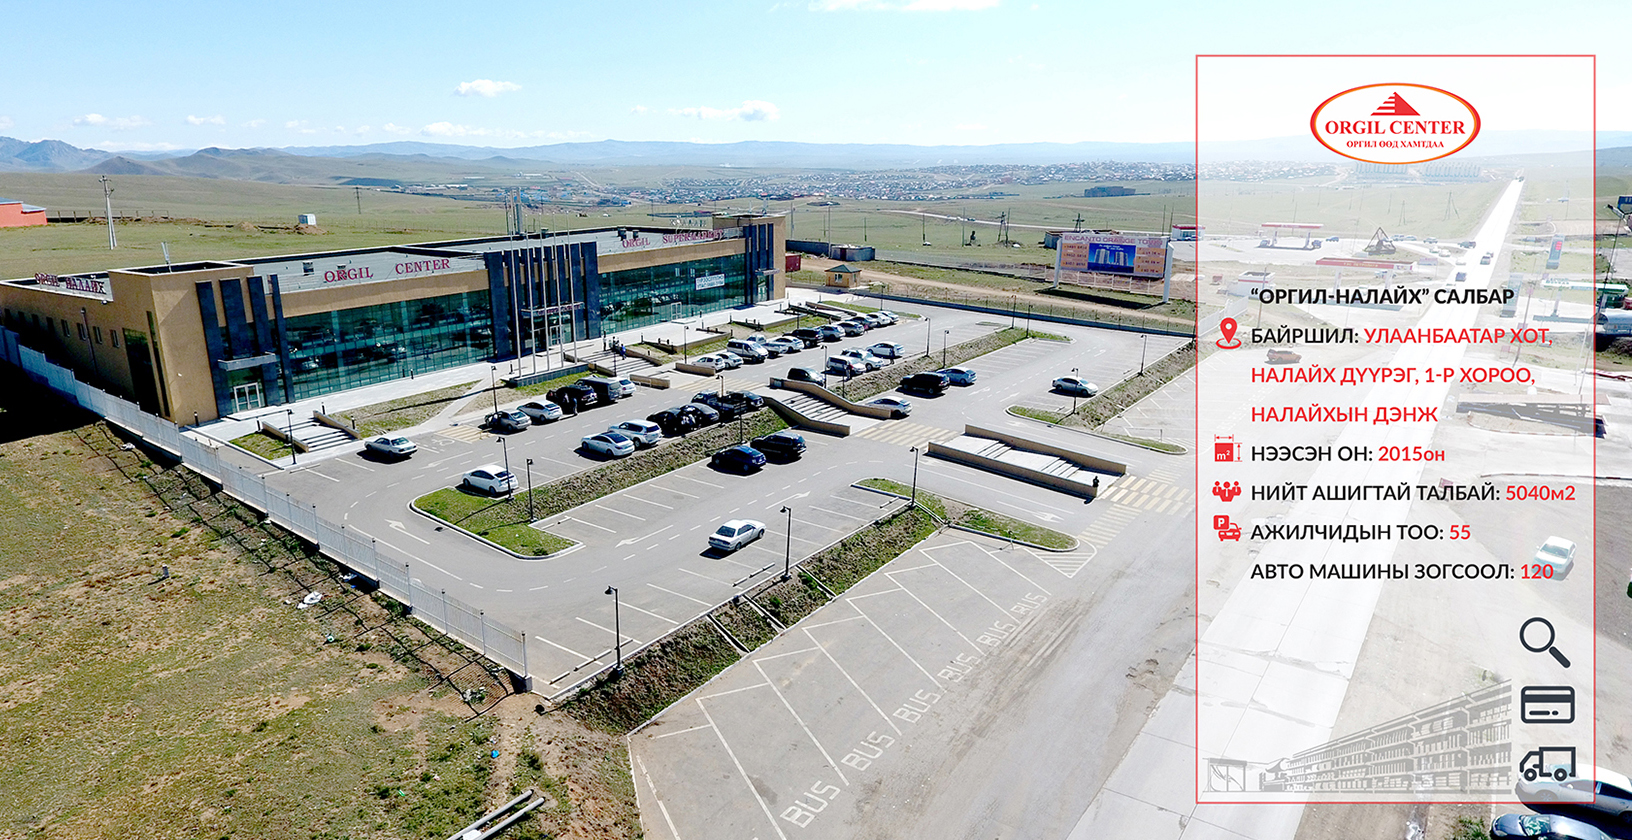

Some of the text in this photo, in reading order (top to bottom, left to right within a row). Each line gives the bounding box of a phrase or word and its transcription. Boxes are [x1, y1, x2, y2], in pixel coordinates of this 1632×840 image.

[622, 237, 651, 249] ORGIL
[1064, 235, 1101, 243] ENCANTO
[324, 258, 450, 283] ORGIL CENTER
[1010, 592, 1047, 615] BUS
[976, 621, 1018, 647] BUS
[937, 653, 981, 682] BUS
[893, 689, 941, 723] BUS
[841, 731, 895, 771] BUS
[780, 780, 841, 828] BUS
